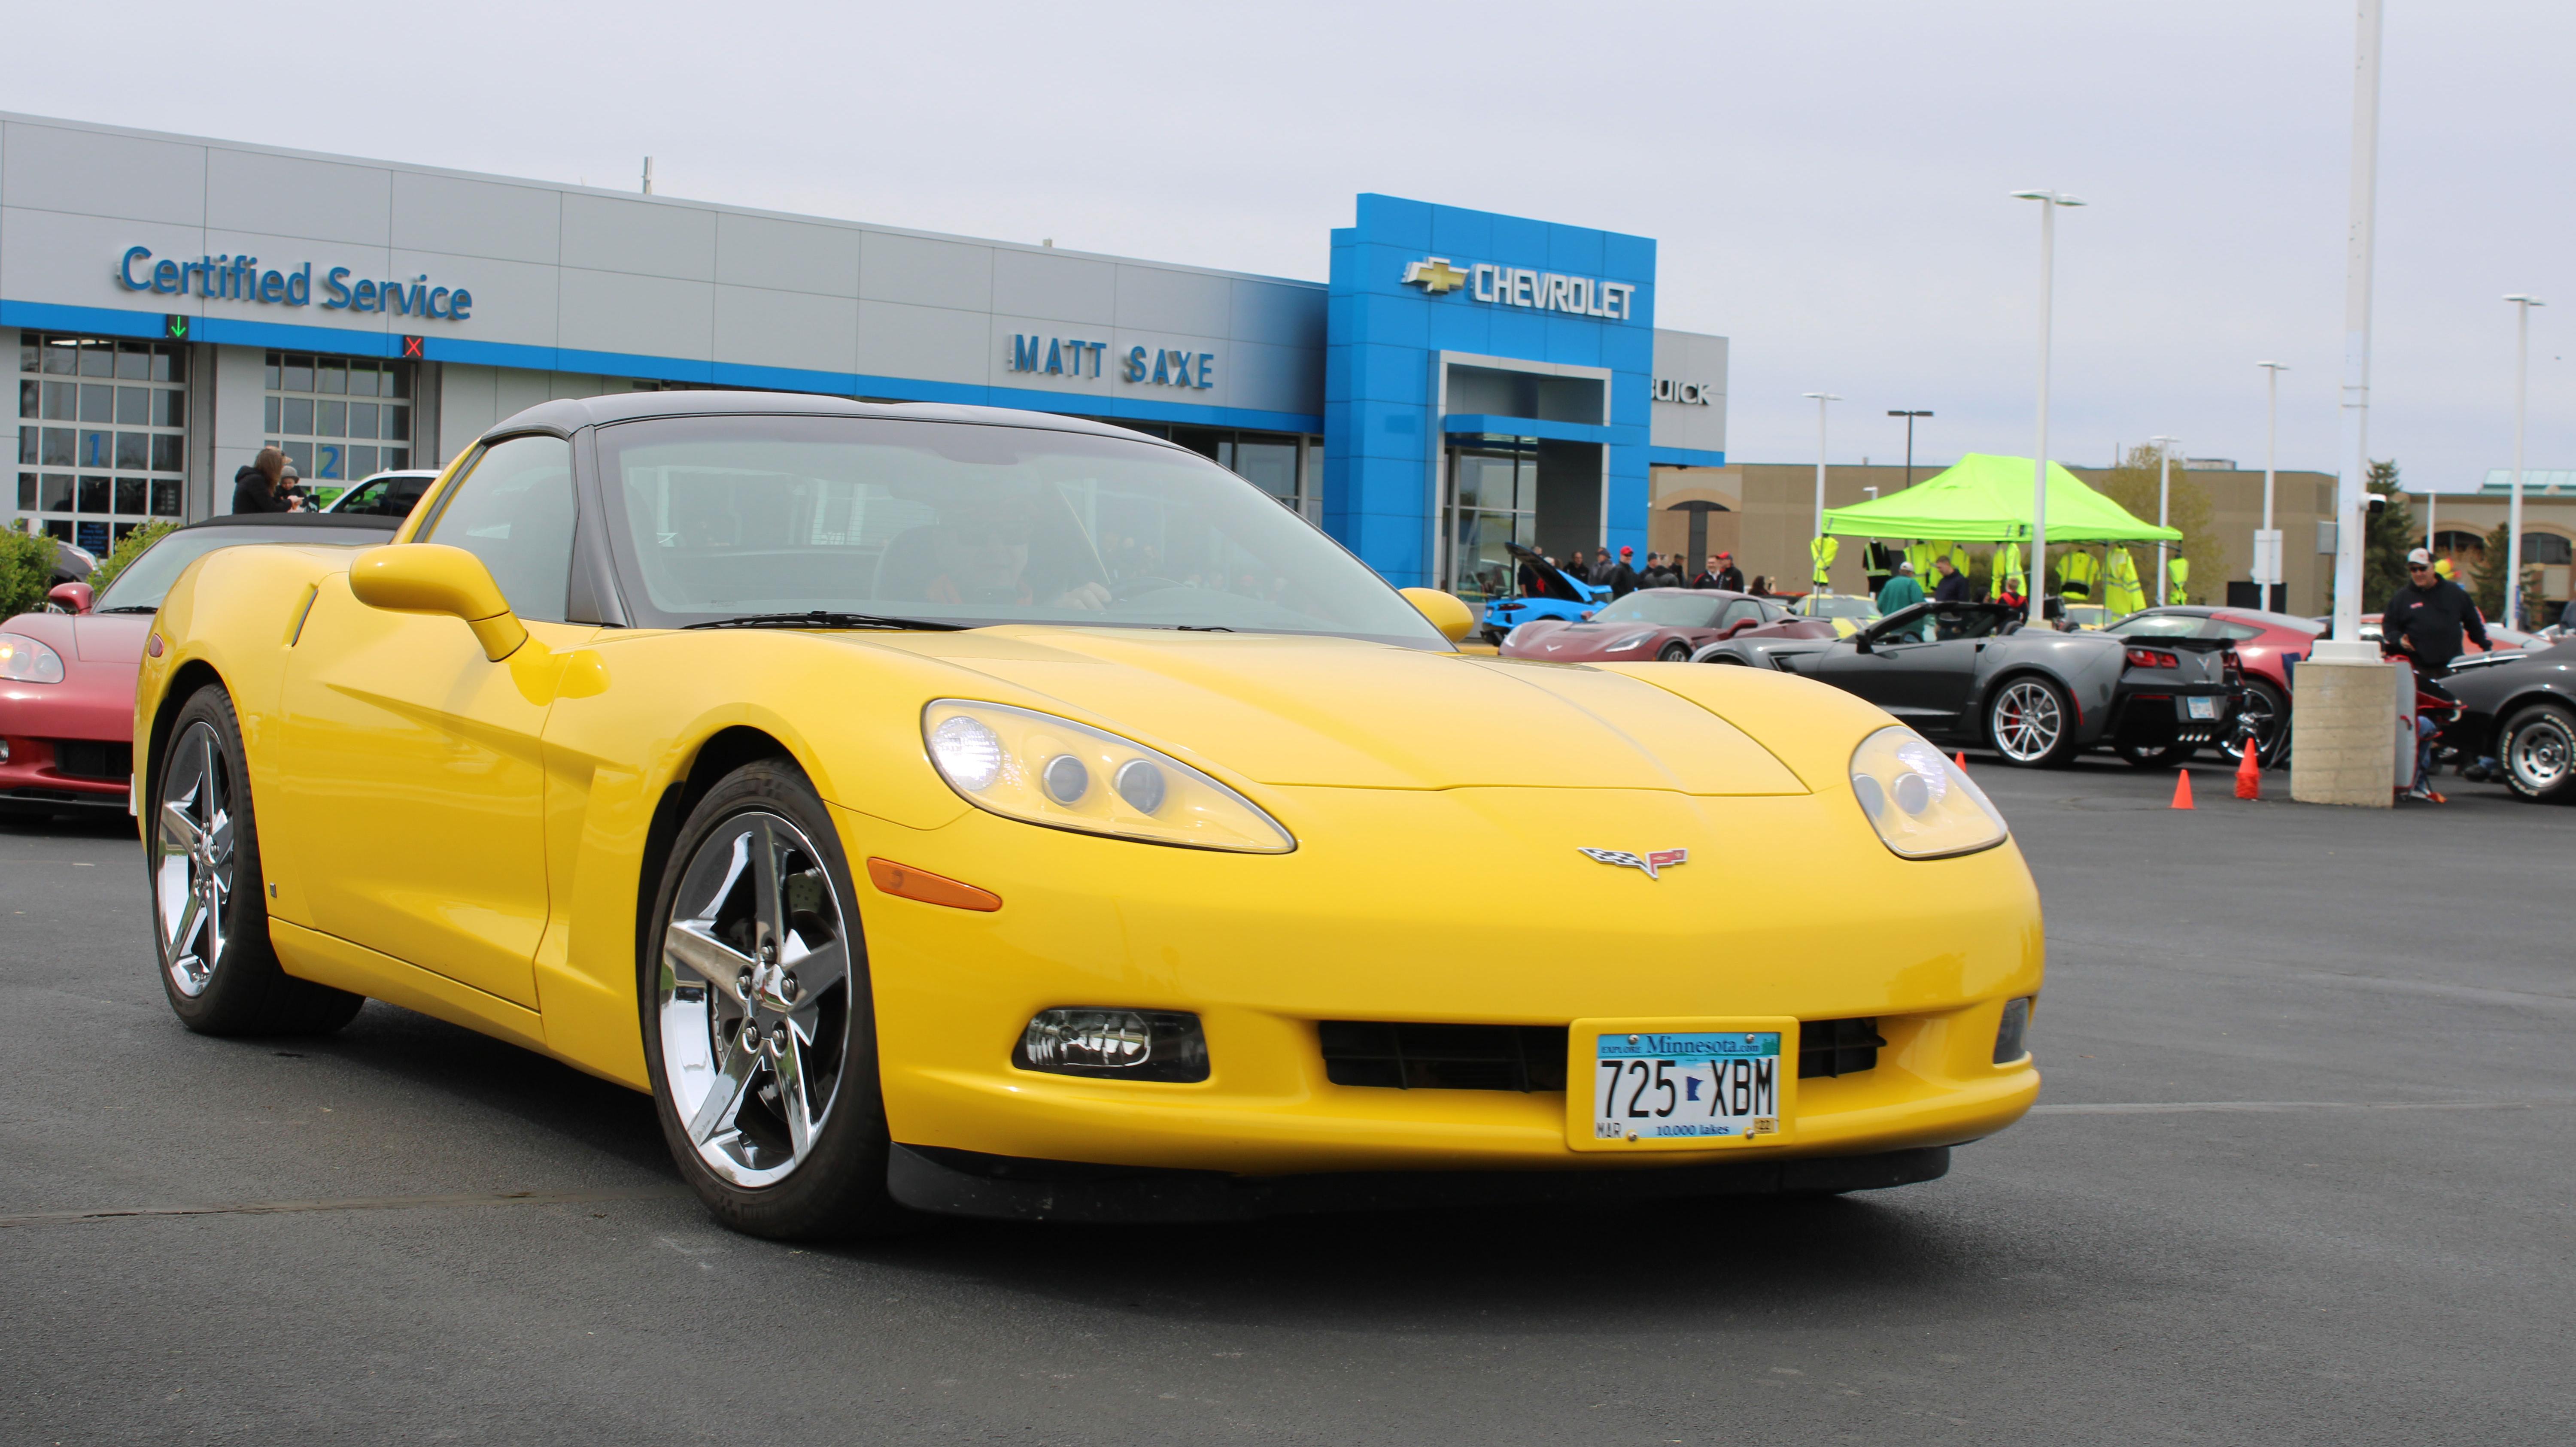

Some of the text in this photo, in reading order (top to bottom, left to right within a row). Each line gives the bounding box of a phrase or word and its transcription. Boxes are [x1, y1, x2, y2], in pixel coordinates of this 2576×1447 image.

[121, 246, 472, 320] Certified Service
[1473, 263, 1635, 320] CHEVROLET
[1014, 334, 1214, 388] MATT SAXE
[89, 433, 100, 467] 1
[321, 446, 339, 478] 2
[1601, 1045, 1642, 1053] EXPLORE
[1601, 1058, 1772, 1118] 725 XBM
[1596, 1122, 1622, 1139] MAR
[1656, 1123, 1730, 1136] 10,000 lakes
